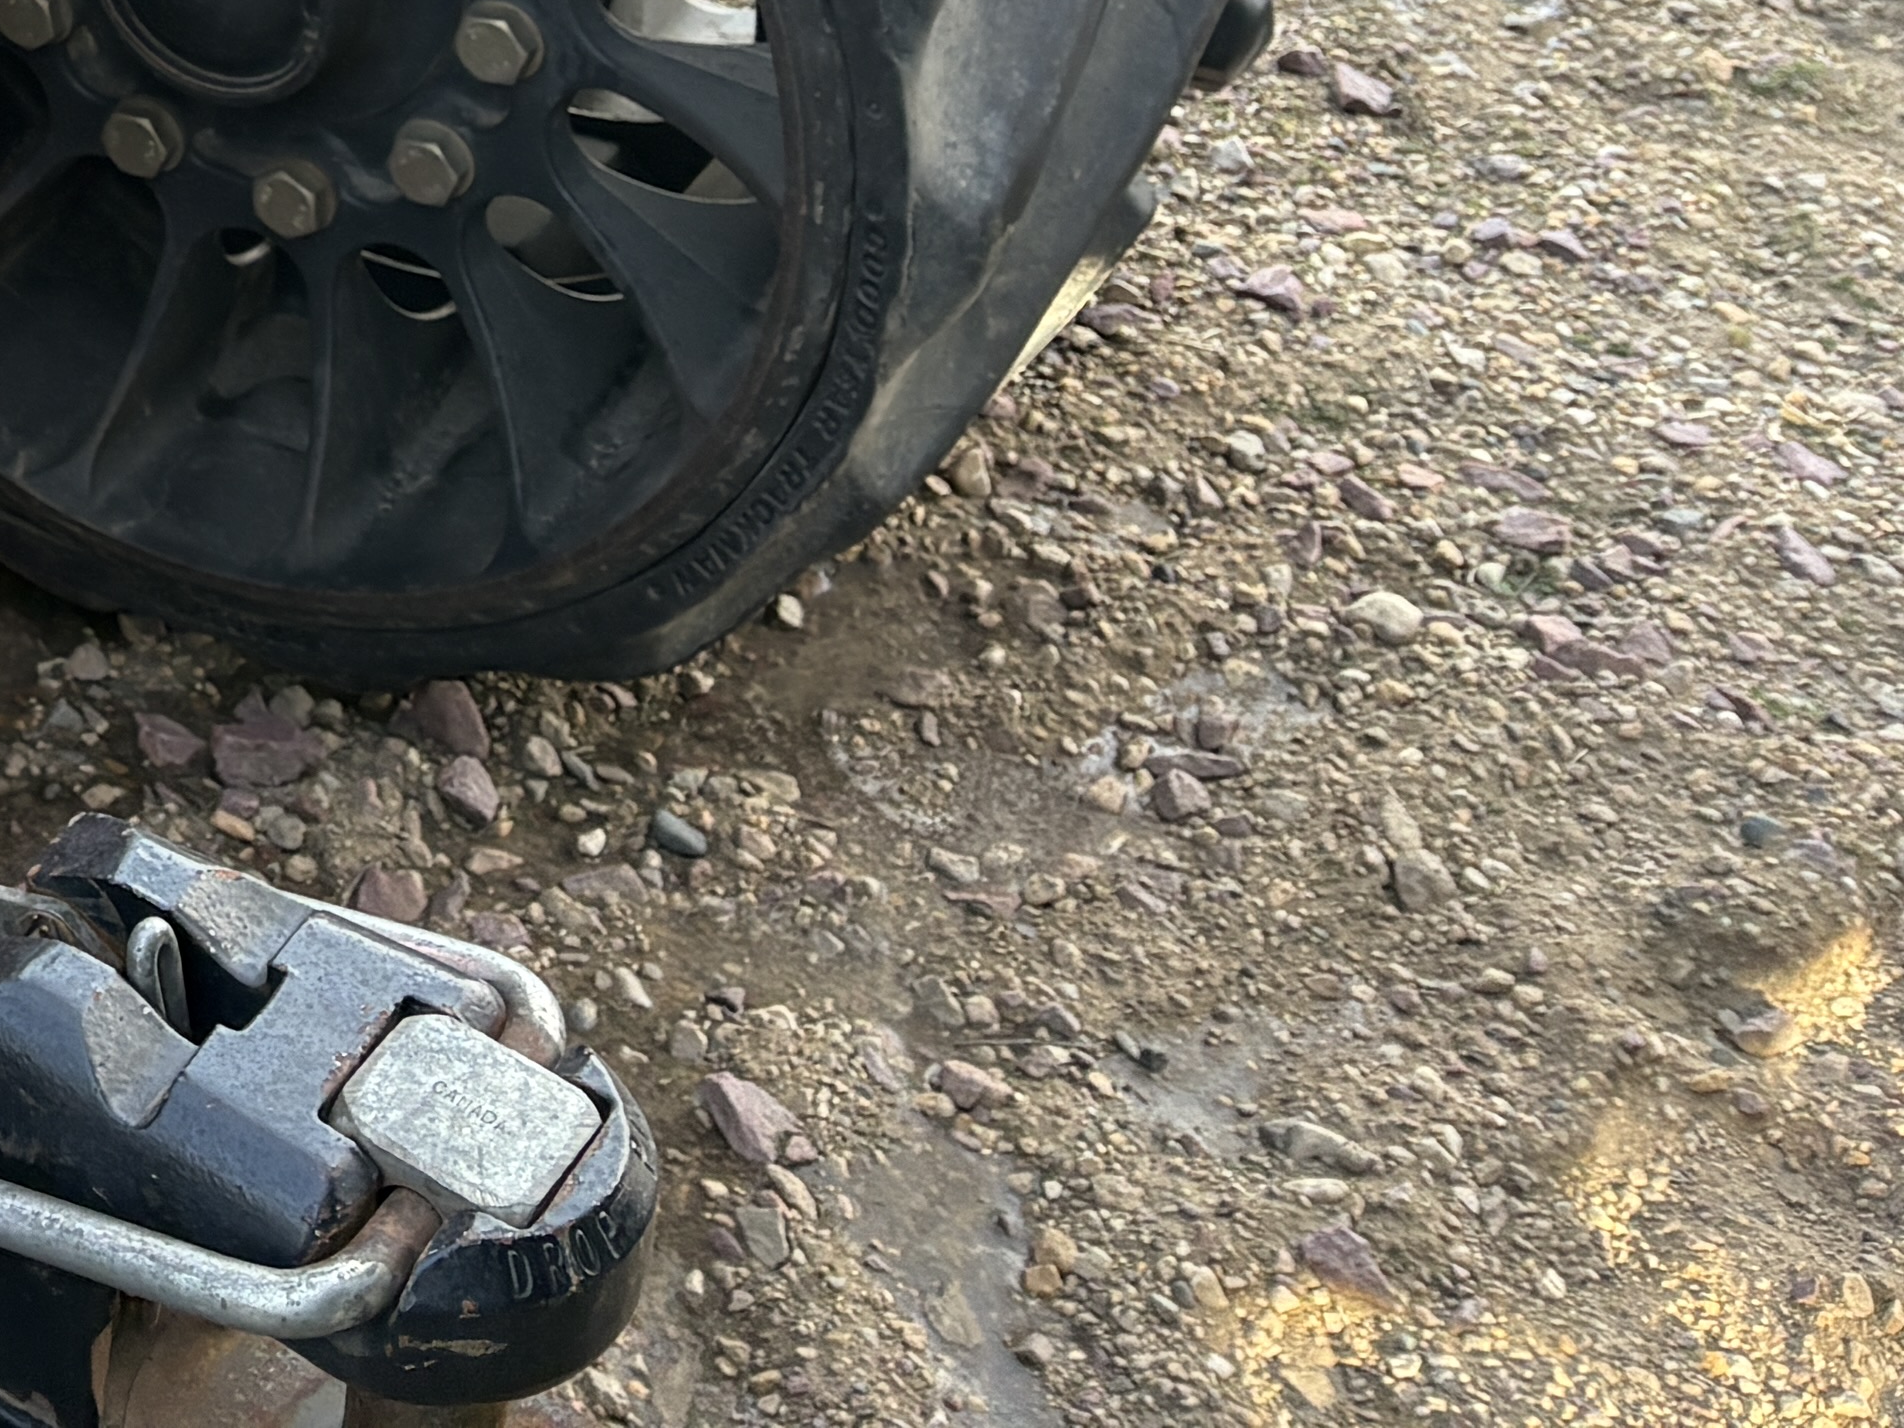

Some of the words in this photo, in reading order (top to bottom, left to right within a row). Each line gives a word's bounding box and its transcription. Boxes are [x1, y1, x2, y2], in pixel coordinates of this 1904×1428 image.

[813, 231, 890, 443] GOODYEAR
[668, 444, 818, 601] TRACKMAN
[431, 1079, 509, 1137] CANADA
[506, 1207, 624, 1301] DROP
